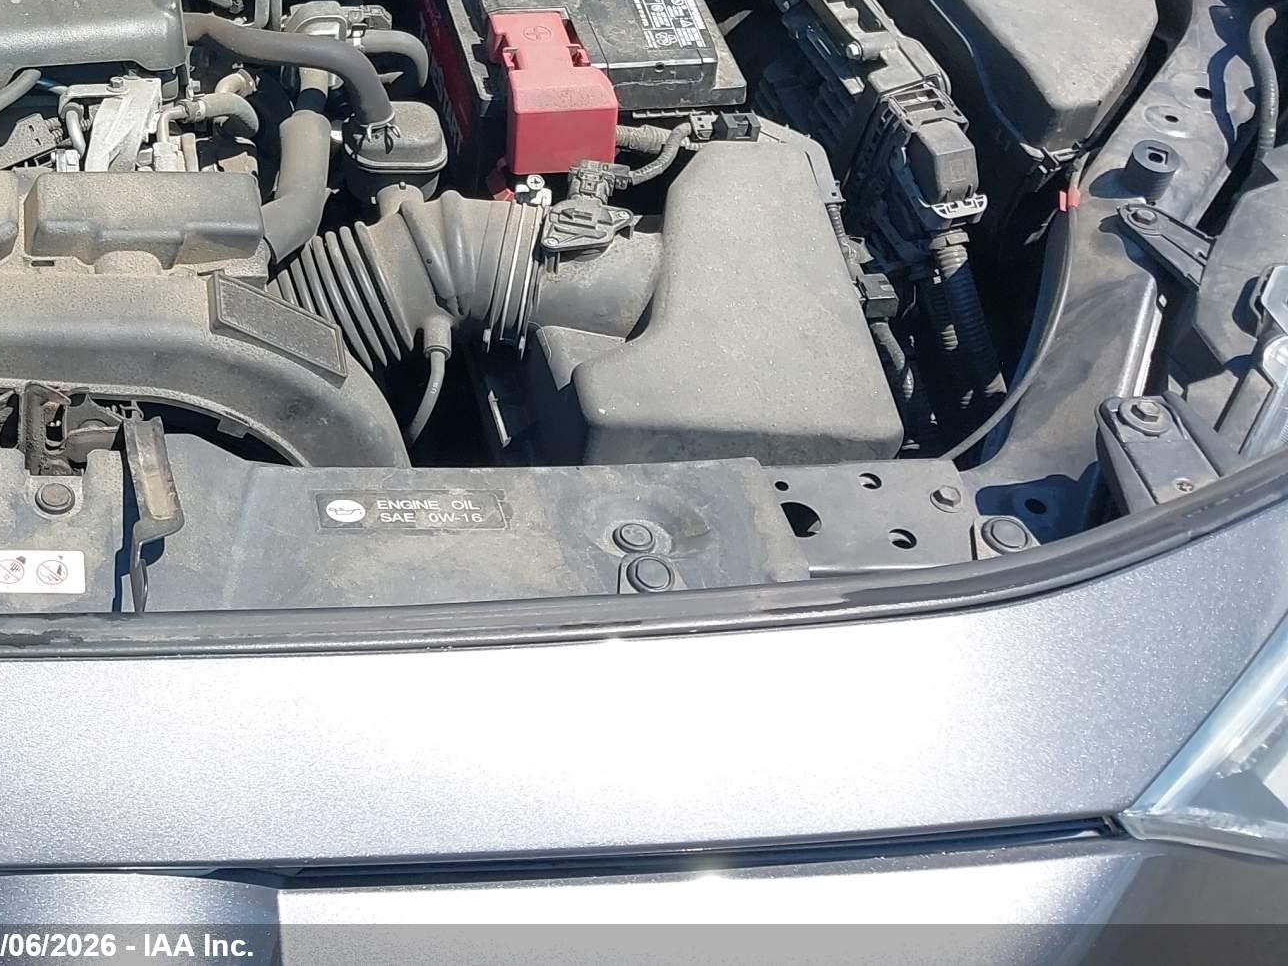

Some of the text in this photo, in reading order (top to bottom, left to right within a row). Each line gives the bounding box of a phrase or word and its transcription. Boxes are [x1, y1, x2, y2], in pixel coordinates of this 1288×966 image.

[376, 499, 481, 511] ENGINE OIL
[380, 512, 483, 523] SAE 0W-16
